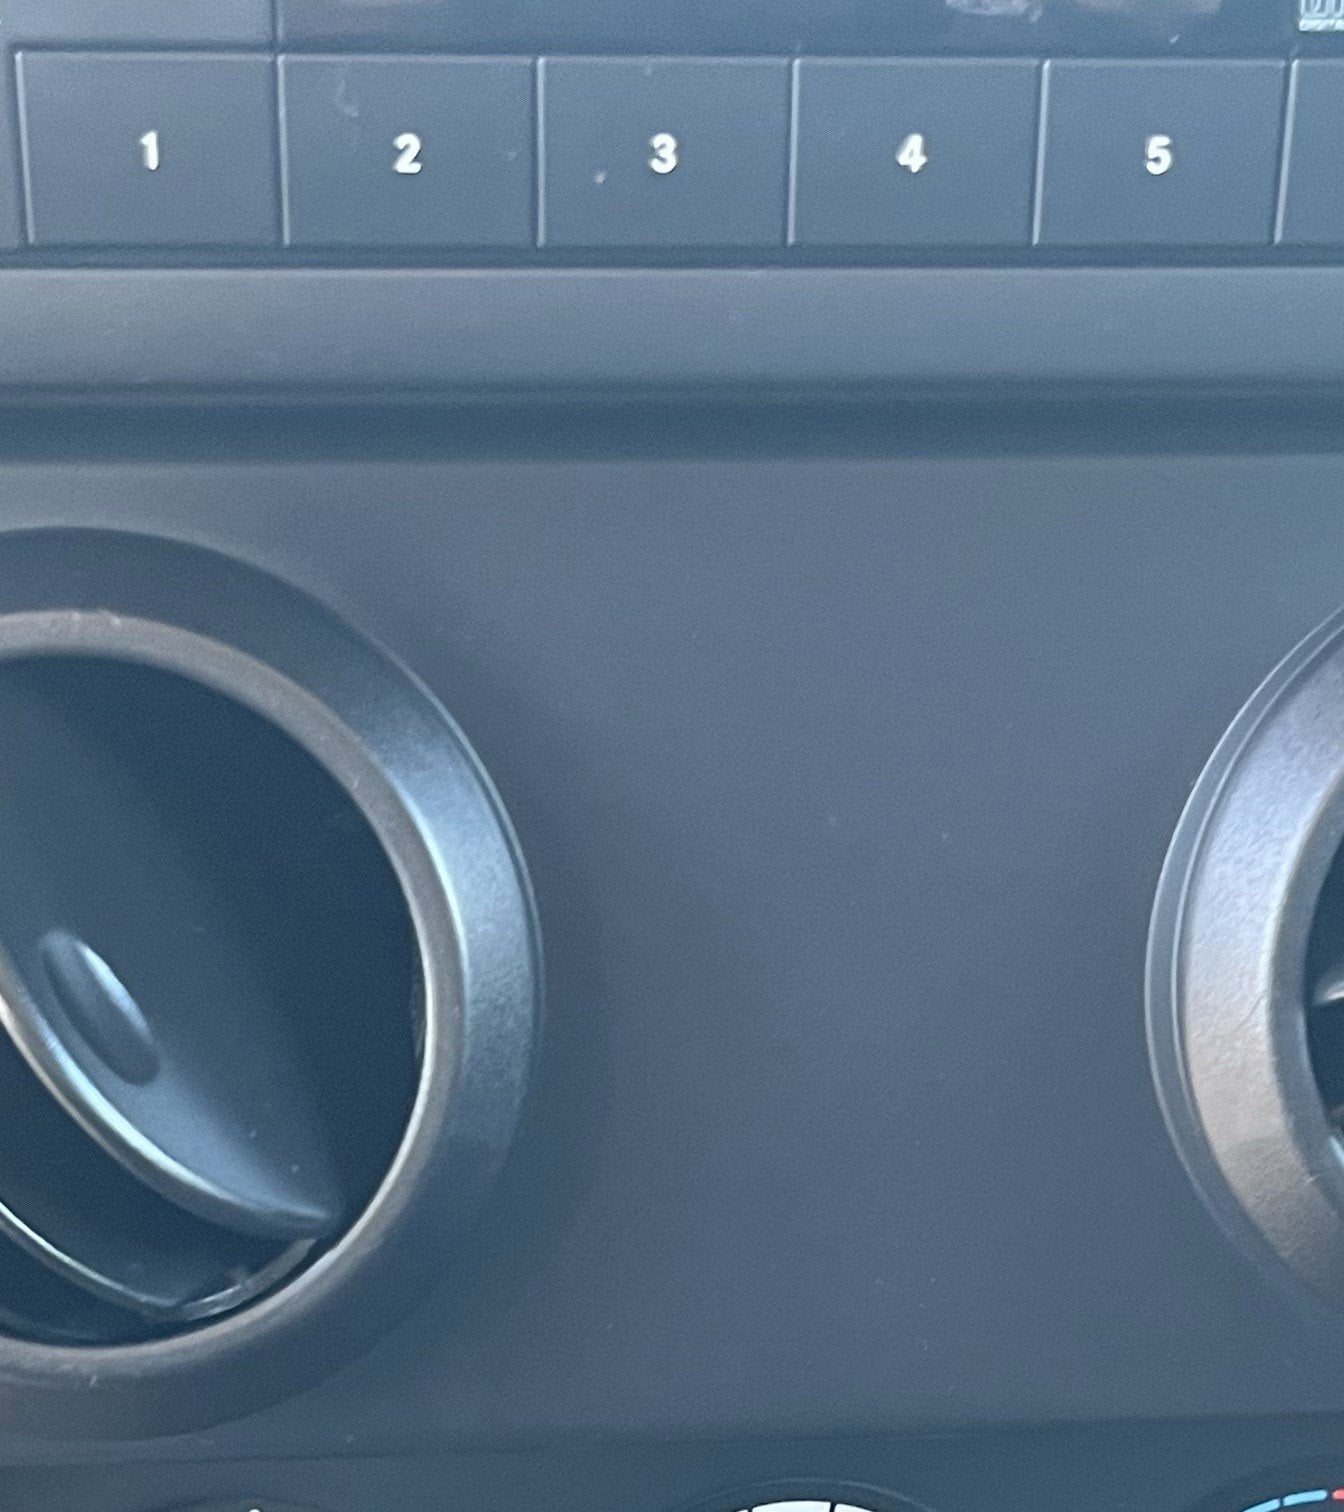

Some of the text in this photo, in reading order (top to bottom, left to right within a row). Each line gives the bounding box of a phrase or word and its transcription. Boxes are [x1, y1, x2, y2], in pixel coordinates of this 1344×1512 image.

[139, 130, 160, 171] 1
[393, 132, 423, 174] 2
[649, 132, 678, 174] 3
[895, 133, 928, 173] 4
[1143, 134, 1173, 175] 5
